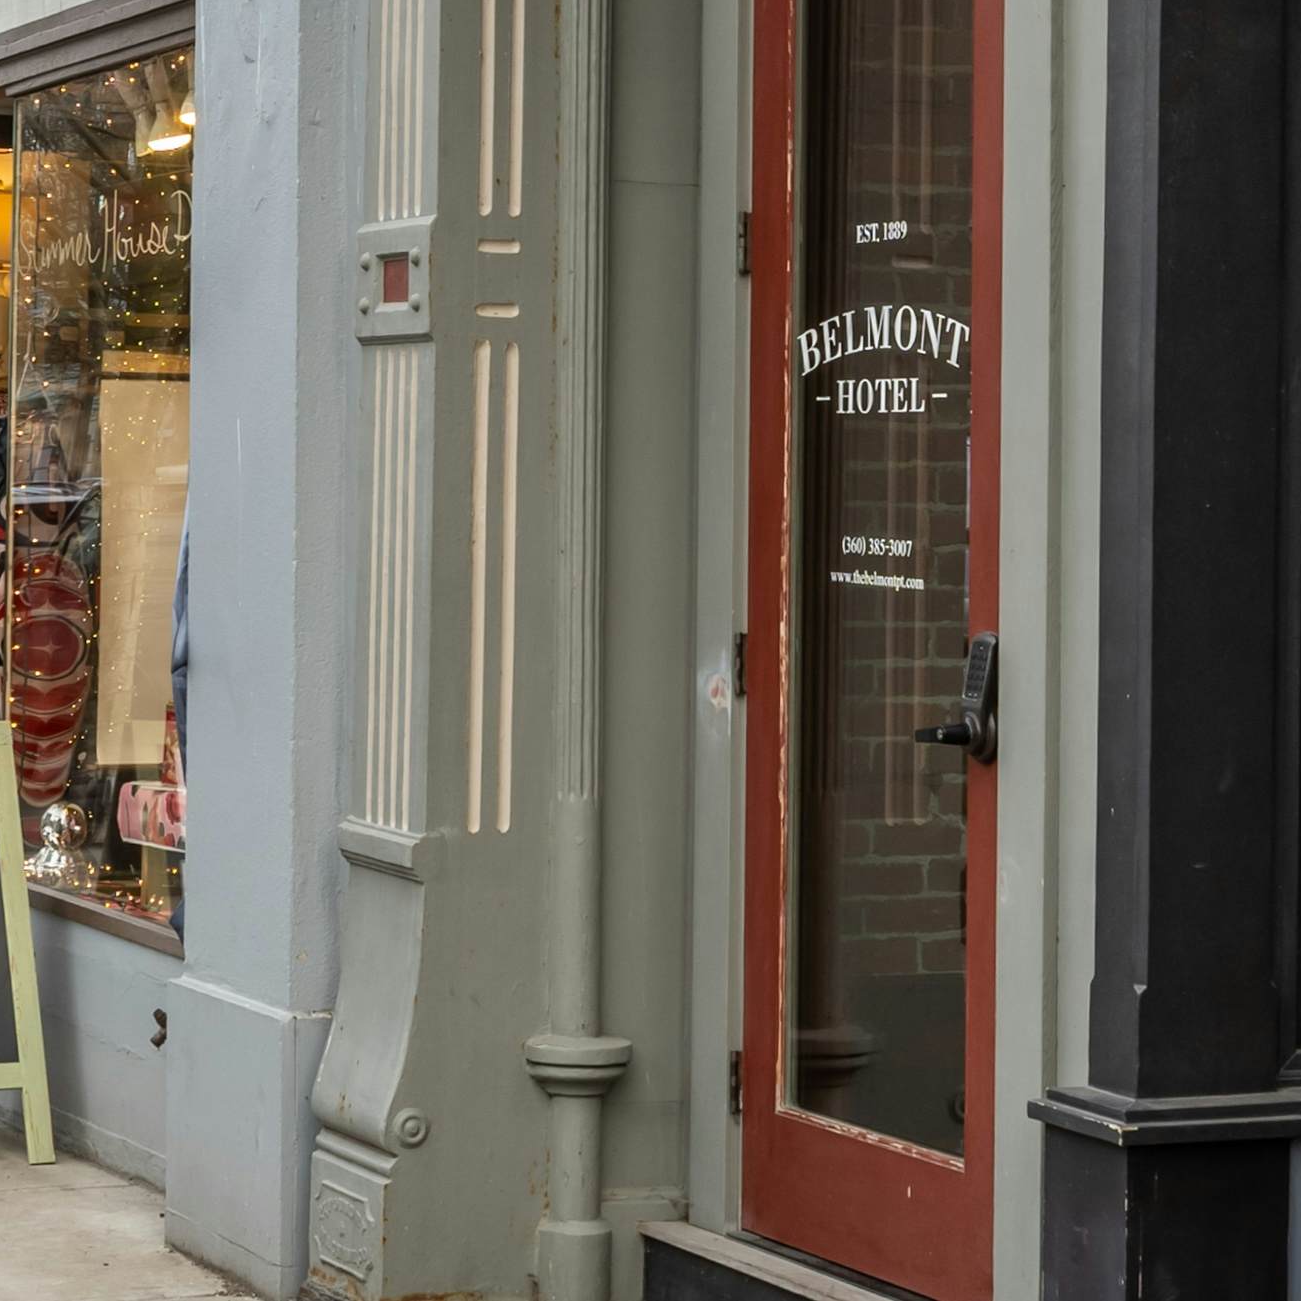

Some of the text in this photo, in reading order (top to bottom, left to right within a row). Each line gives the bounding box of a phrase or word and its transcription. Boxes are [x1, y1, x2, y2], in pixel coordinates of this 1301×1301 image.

[882, 220, 908, 242] 1889
[797, 304, 971, 377] BELMONT
[835, 378, 926, 414] HOTEL
[841, 535, 913, 558] (360) 385-3007
[829, 568, 925, 592] www.thebelmontpt.com
